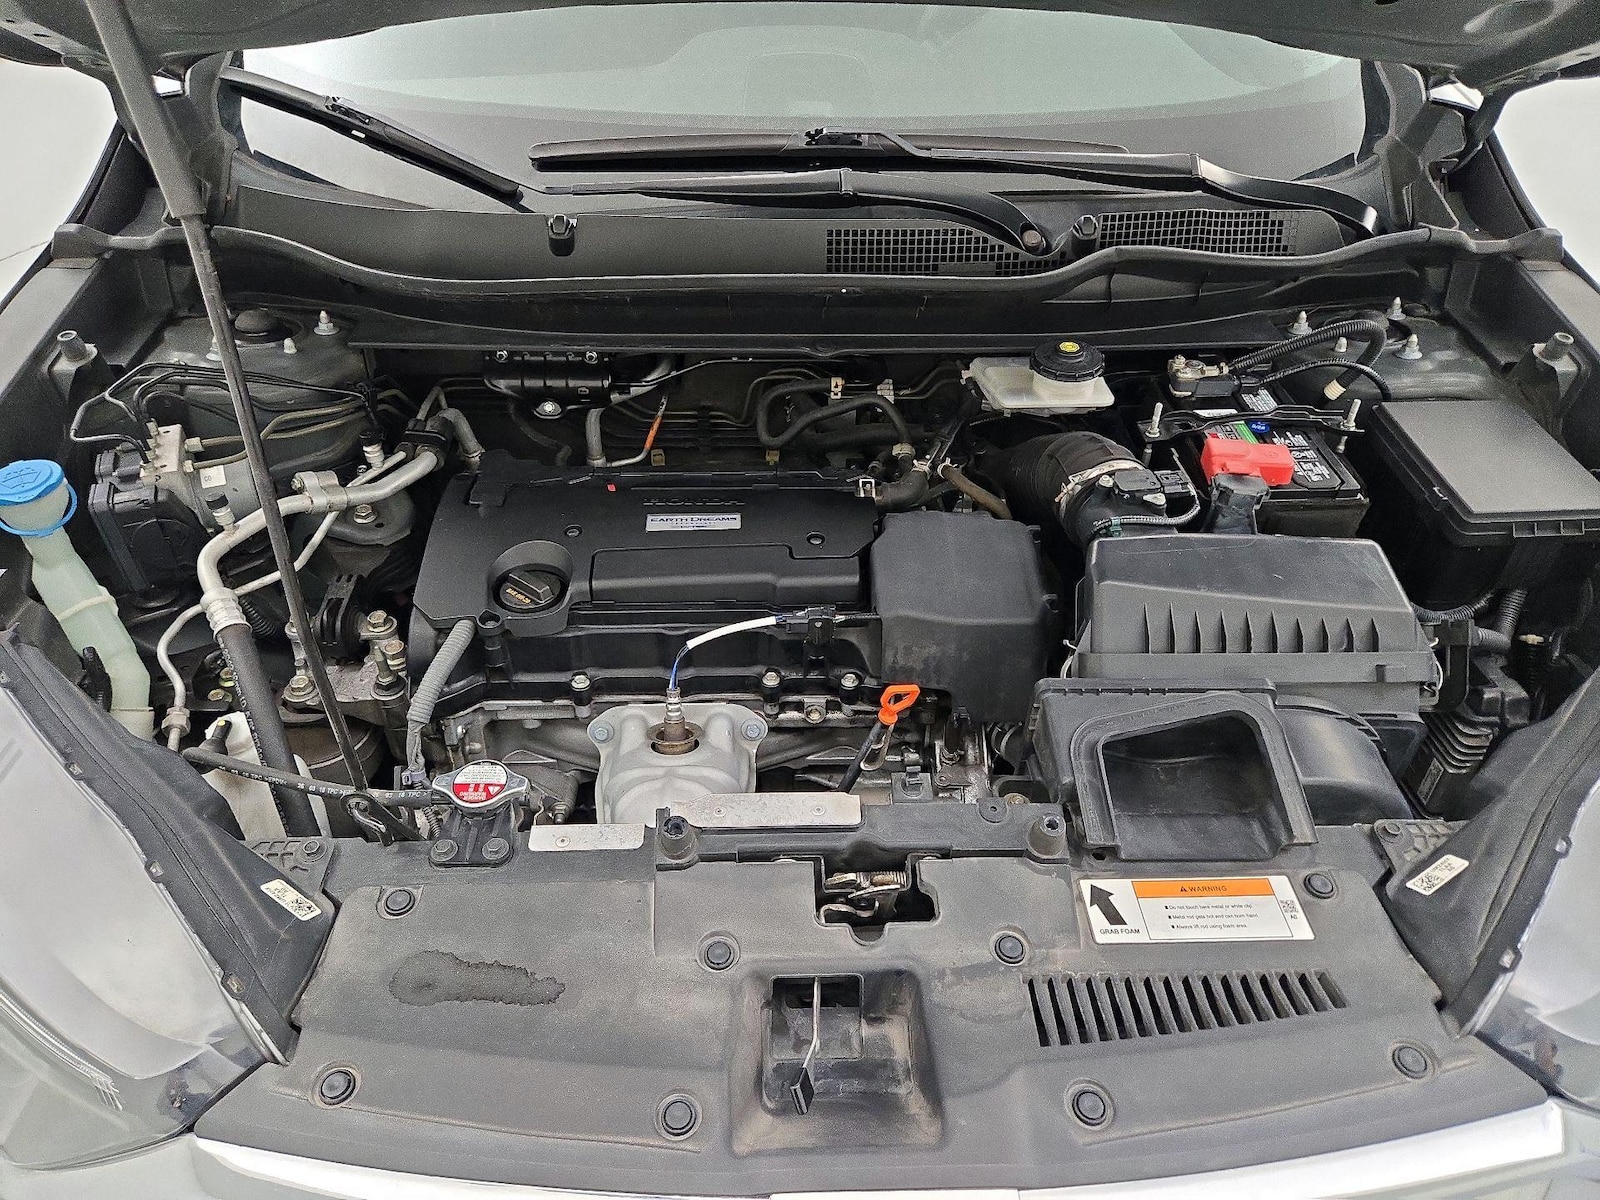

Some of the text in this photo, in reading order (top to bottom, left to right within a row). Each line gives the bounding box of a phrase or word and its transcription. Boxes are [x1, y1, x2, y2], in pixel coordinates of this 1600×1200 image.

[1187, 884, 1229, 894] WARNING
[1099, 928, 1141, 936] GRAB FOAM
